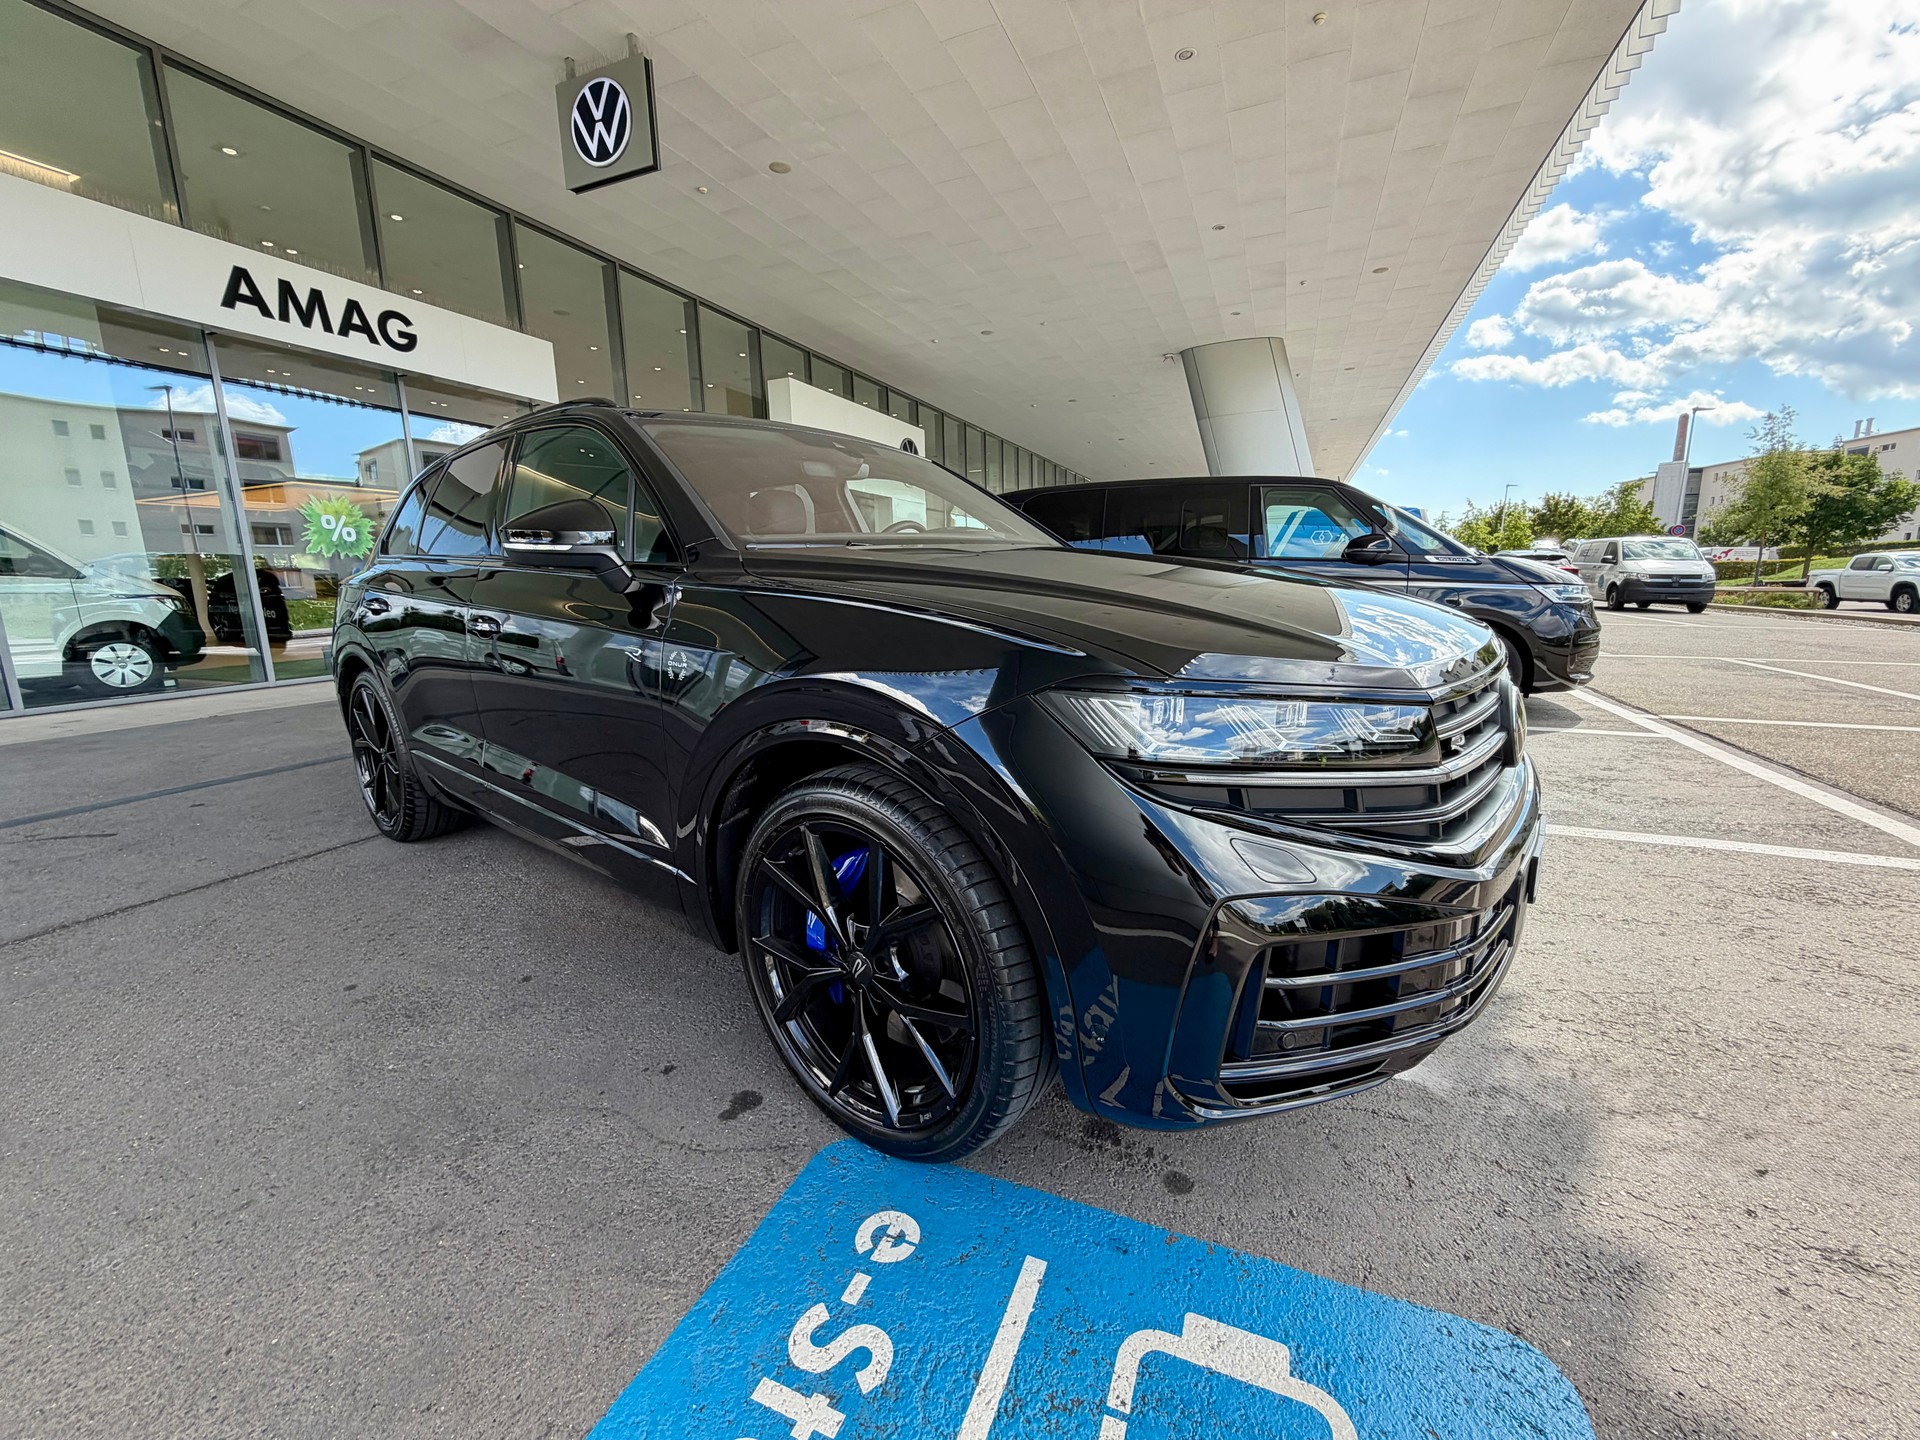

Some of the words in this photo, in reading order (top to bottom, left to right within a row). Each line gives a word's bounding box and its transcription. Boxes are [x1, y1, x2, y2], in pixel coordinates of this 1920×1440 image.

[572, 77, 631, 166] VW
[220, 264, 418, 353] AMAG
[735, 1210, 921, 1440] e-St
